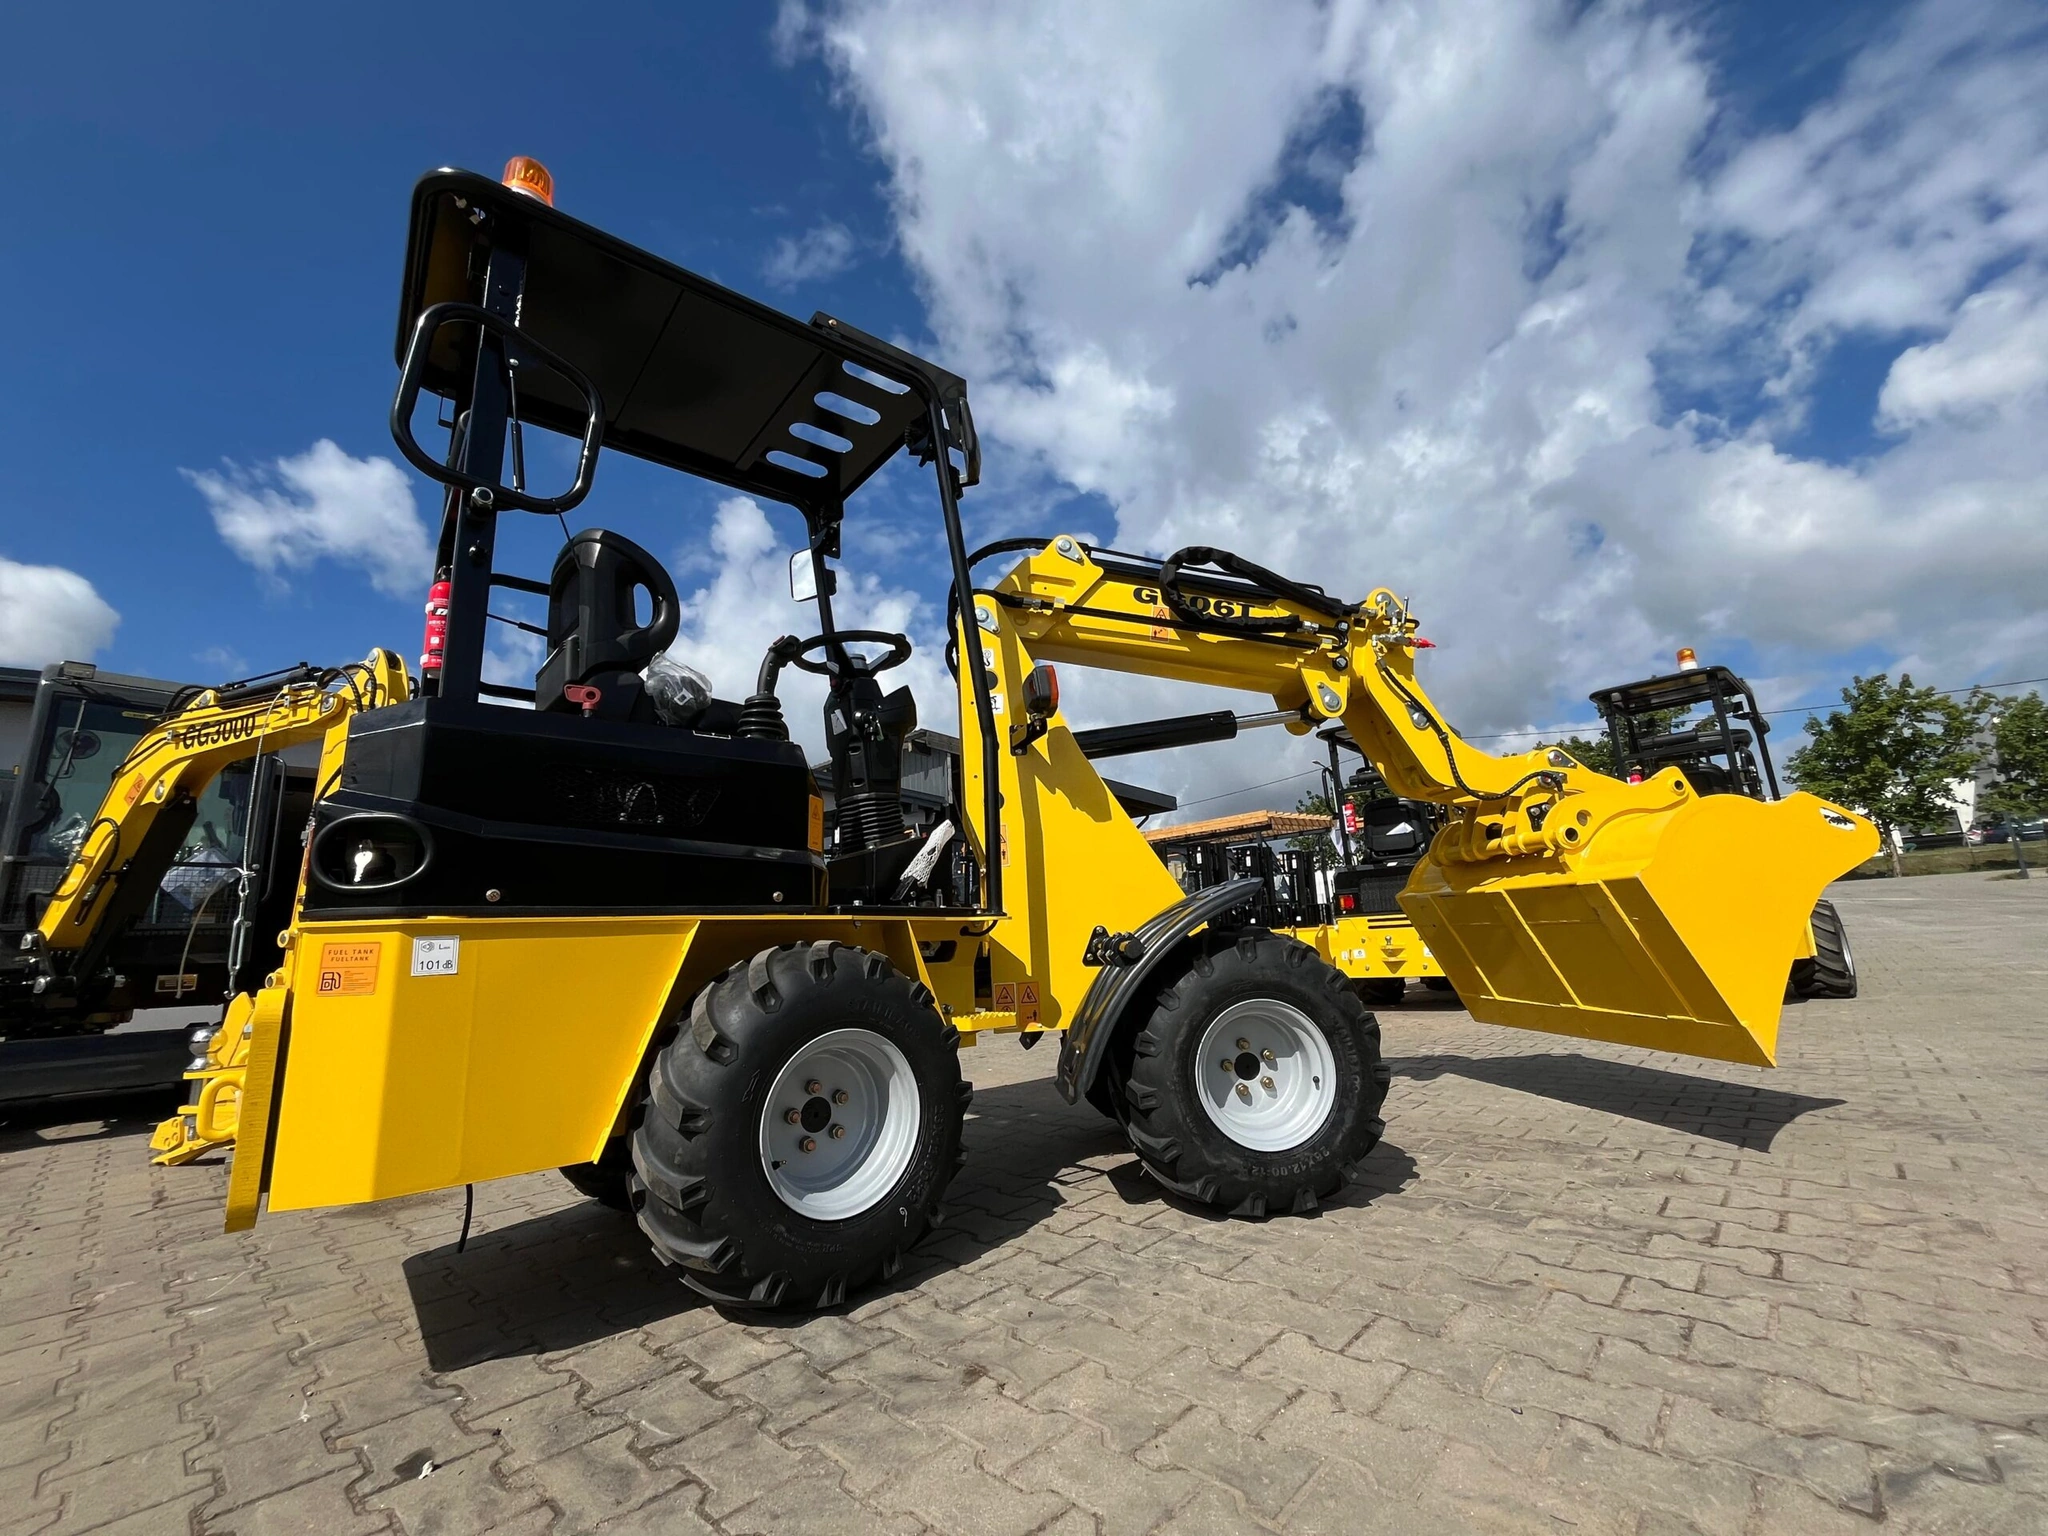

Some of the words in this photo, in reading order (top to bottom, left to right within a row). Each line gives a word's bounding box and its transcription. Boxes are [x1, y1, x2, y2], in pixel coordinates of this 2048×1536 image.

[1133, 587, 1256, 619] G06T
[183, 713, 256, 749] GG3000
[419, 959, 440, 971] 101
